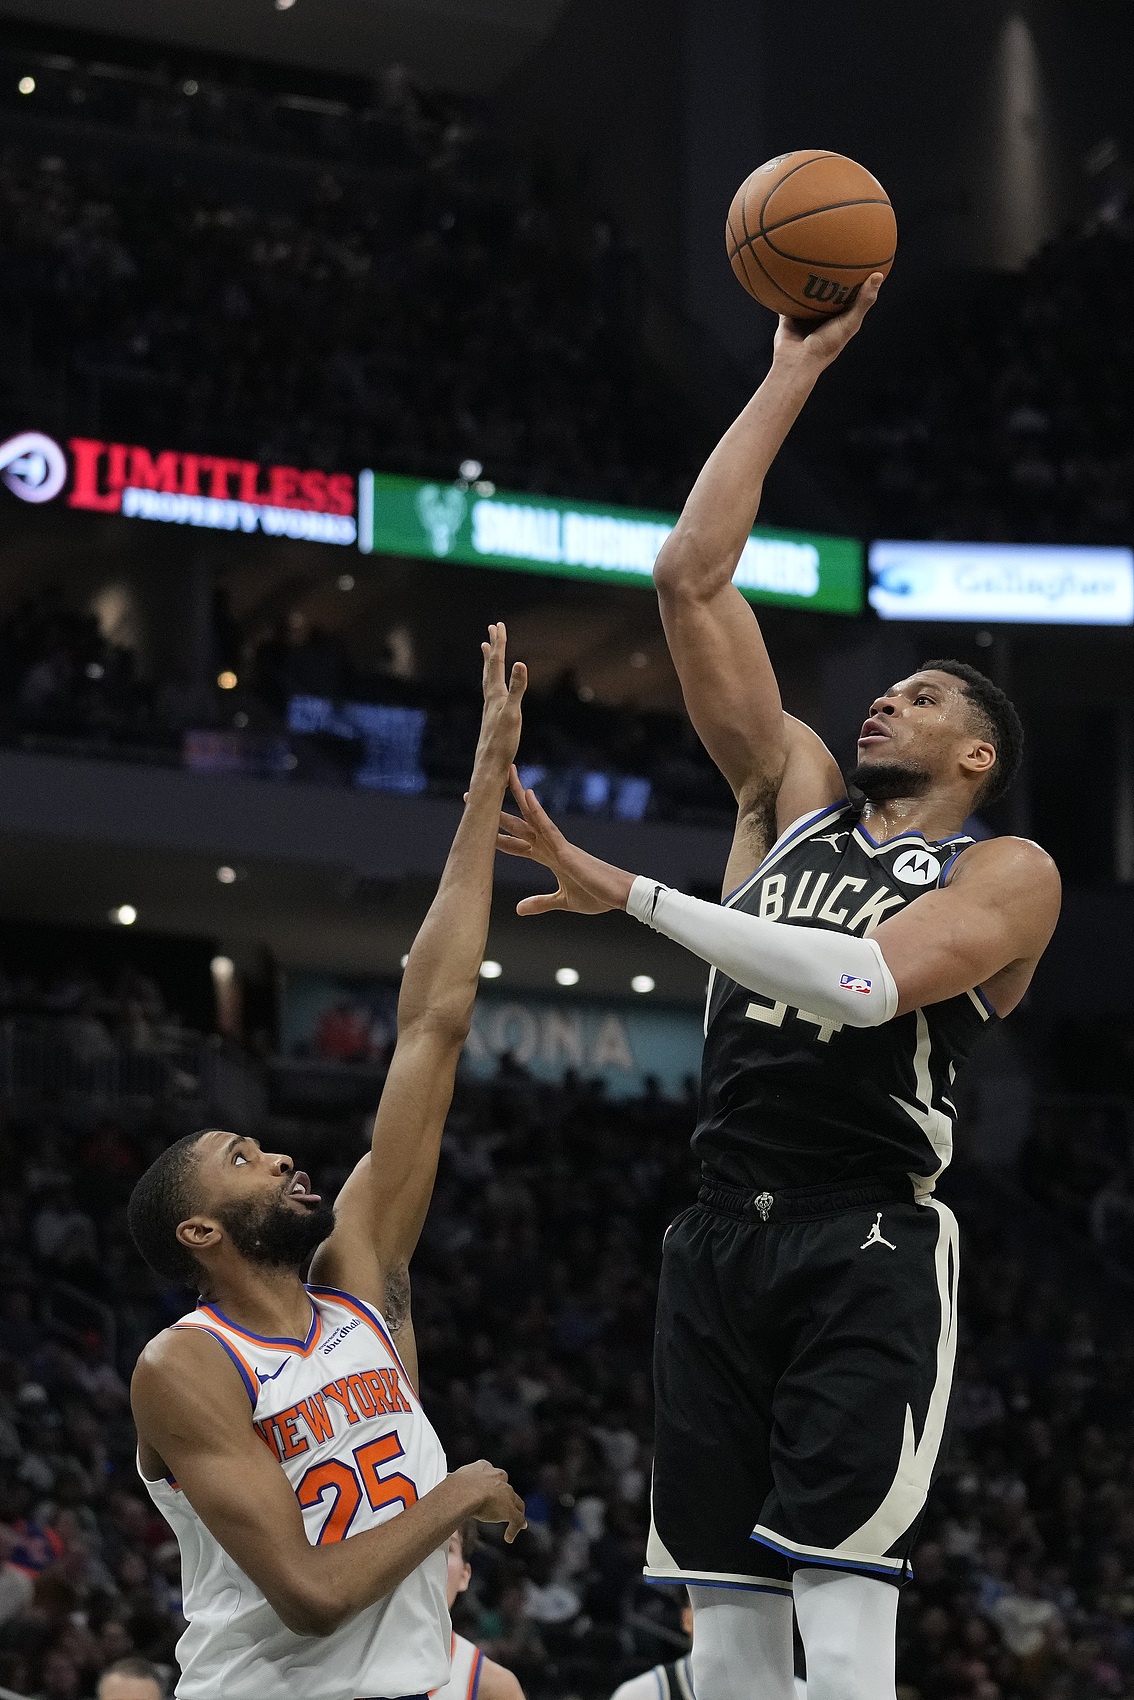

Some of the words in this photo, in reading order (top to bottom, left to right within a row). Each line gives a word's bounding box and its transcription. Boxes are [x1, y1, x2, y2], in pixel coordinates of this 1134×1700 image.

[803, 273, 864, 305] Wil
[68, 437, 355, 516] LIMITLESS
[759, 870, 907, 939] BUCK
[323, 1338, 342, 1355] abu
[339, 1318, 361, 1339] dhab
[252, 1392, 335, 1464] NEW
[321, 1368, 412, 1426] YORK
[294, 1429, 420, 1546] 25
